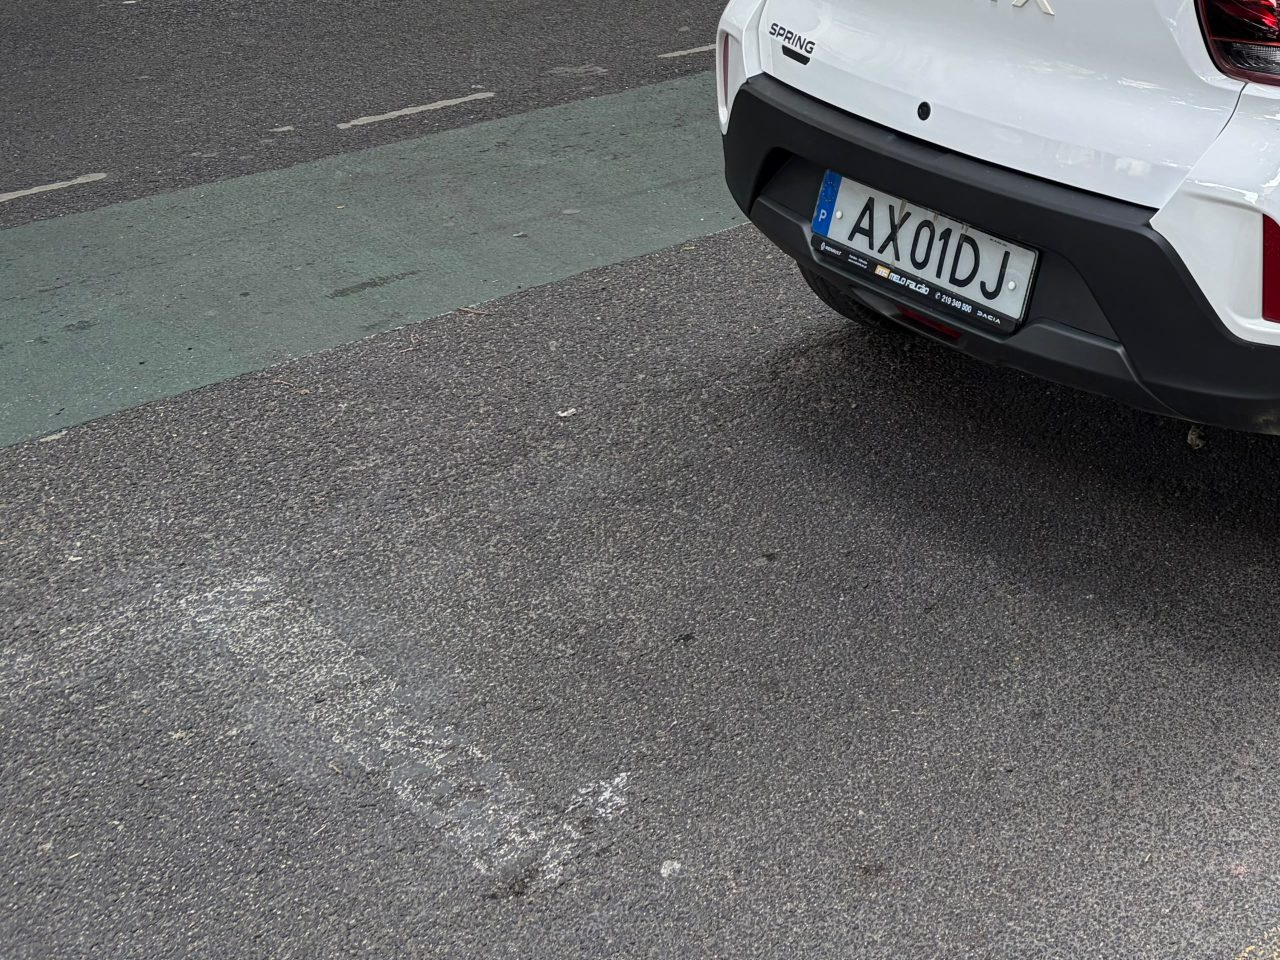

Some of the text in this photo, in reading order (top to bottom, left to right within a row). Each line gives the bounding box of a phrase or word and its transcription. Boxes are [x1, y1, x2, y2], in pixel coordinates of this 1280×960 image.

[769, 22, 816, 55] SPRING
[818, 208, 828, 222] P
[976, 309, 1001, 324] DACIA
